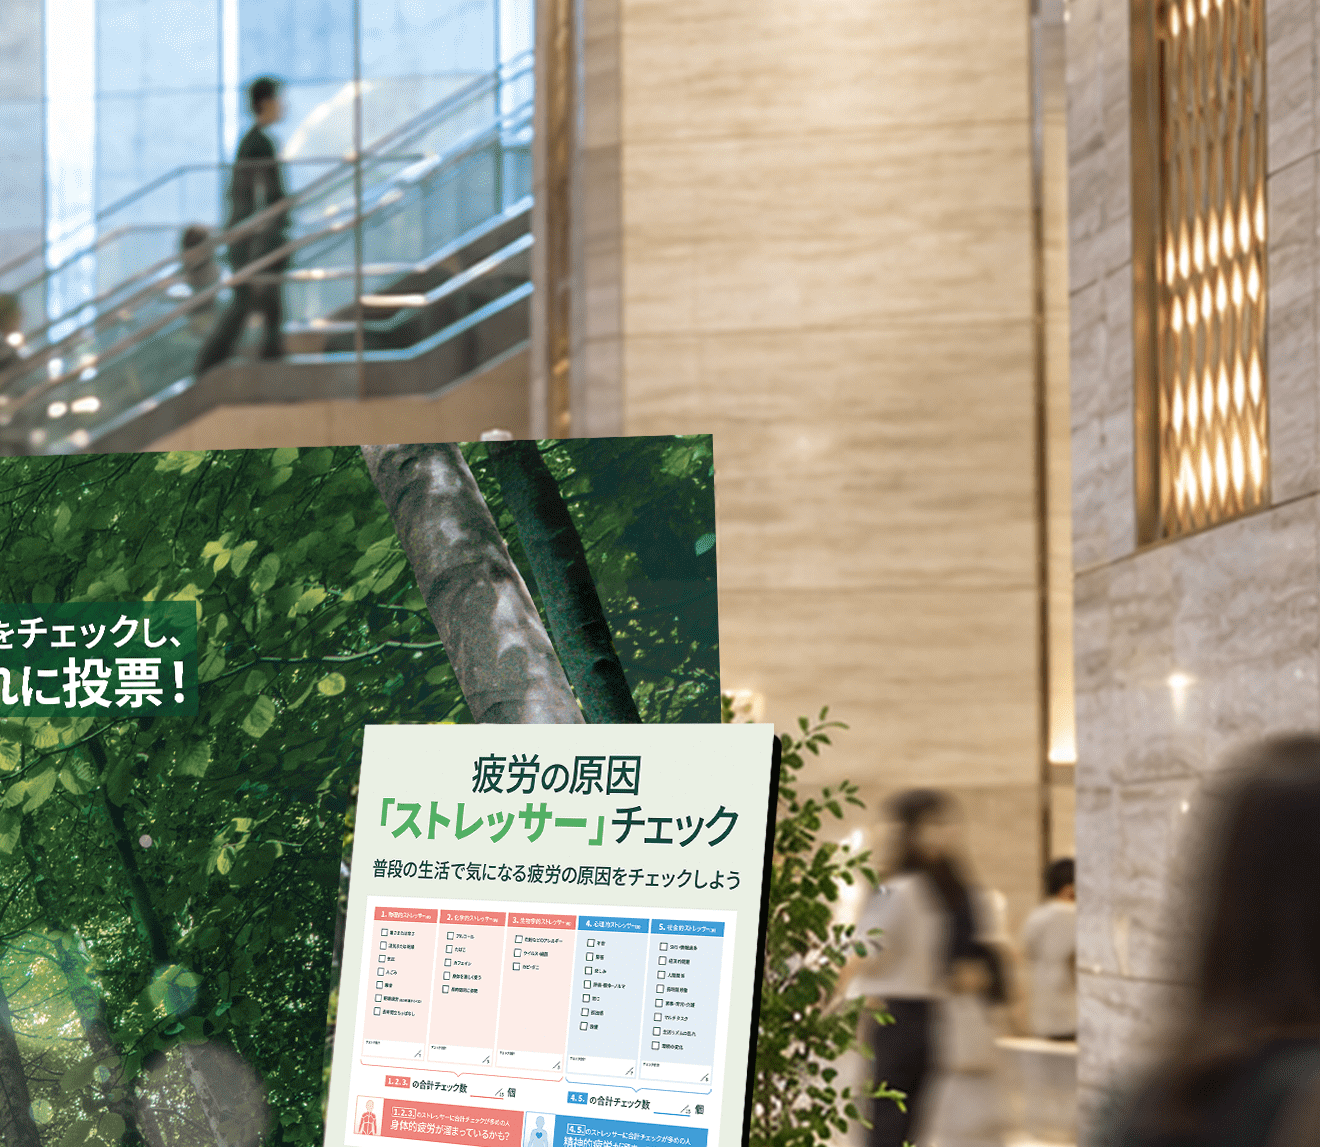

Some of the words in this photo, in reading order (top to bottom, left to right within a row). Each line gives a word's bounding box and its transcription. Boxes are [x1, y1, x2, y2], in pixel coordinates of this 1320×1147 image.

[472, 753, 642, 795] 疲労の原因
[372, 859, 742, 890] 普段の生活で気になる疲労の原因をチェックしよう
[412, 1079, 468, 1095] の合計チェック数
[507, 1087, 516, 1099] 個
[589, 1095, 650, 1111] の合計チェック数
[694, 1103, 705, 1115] 個
